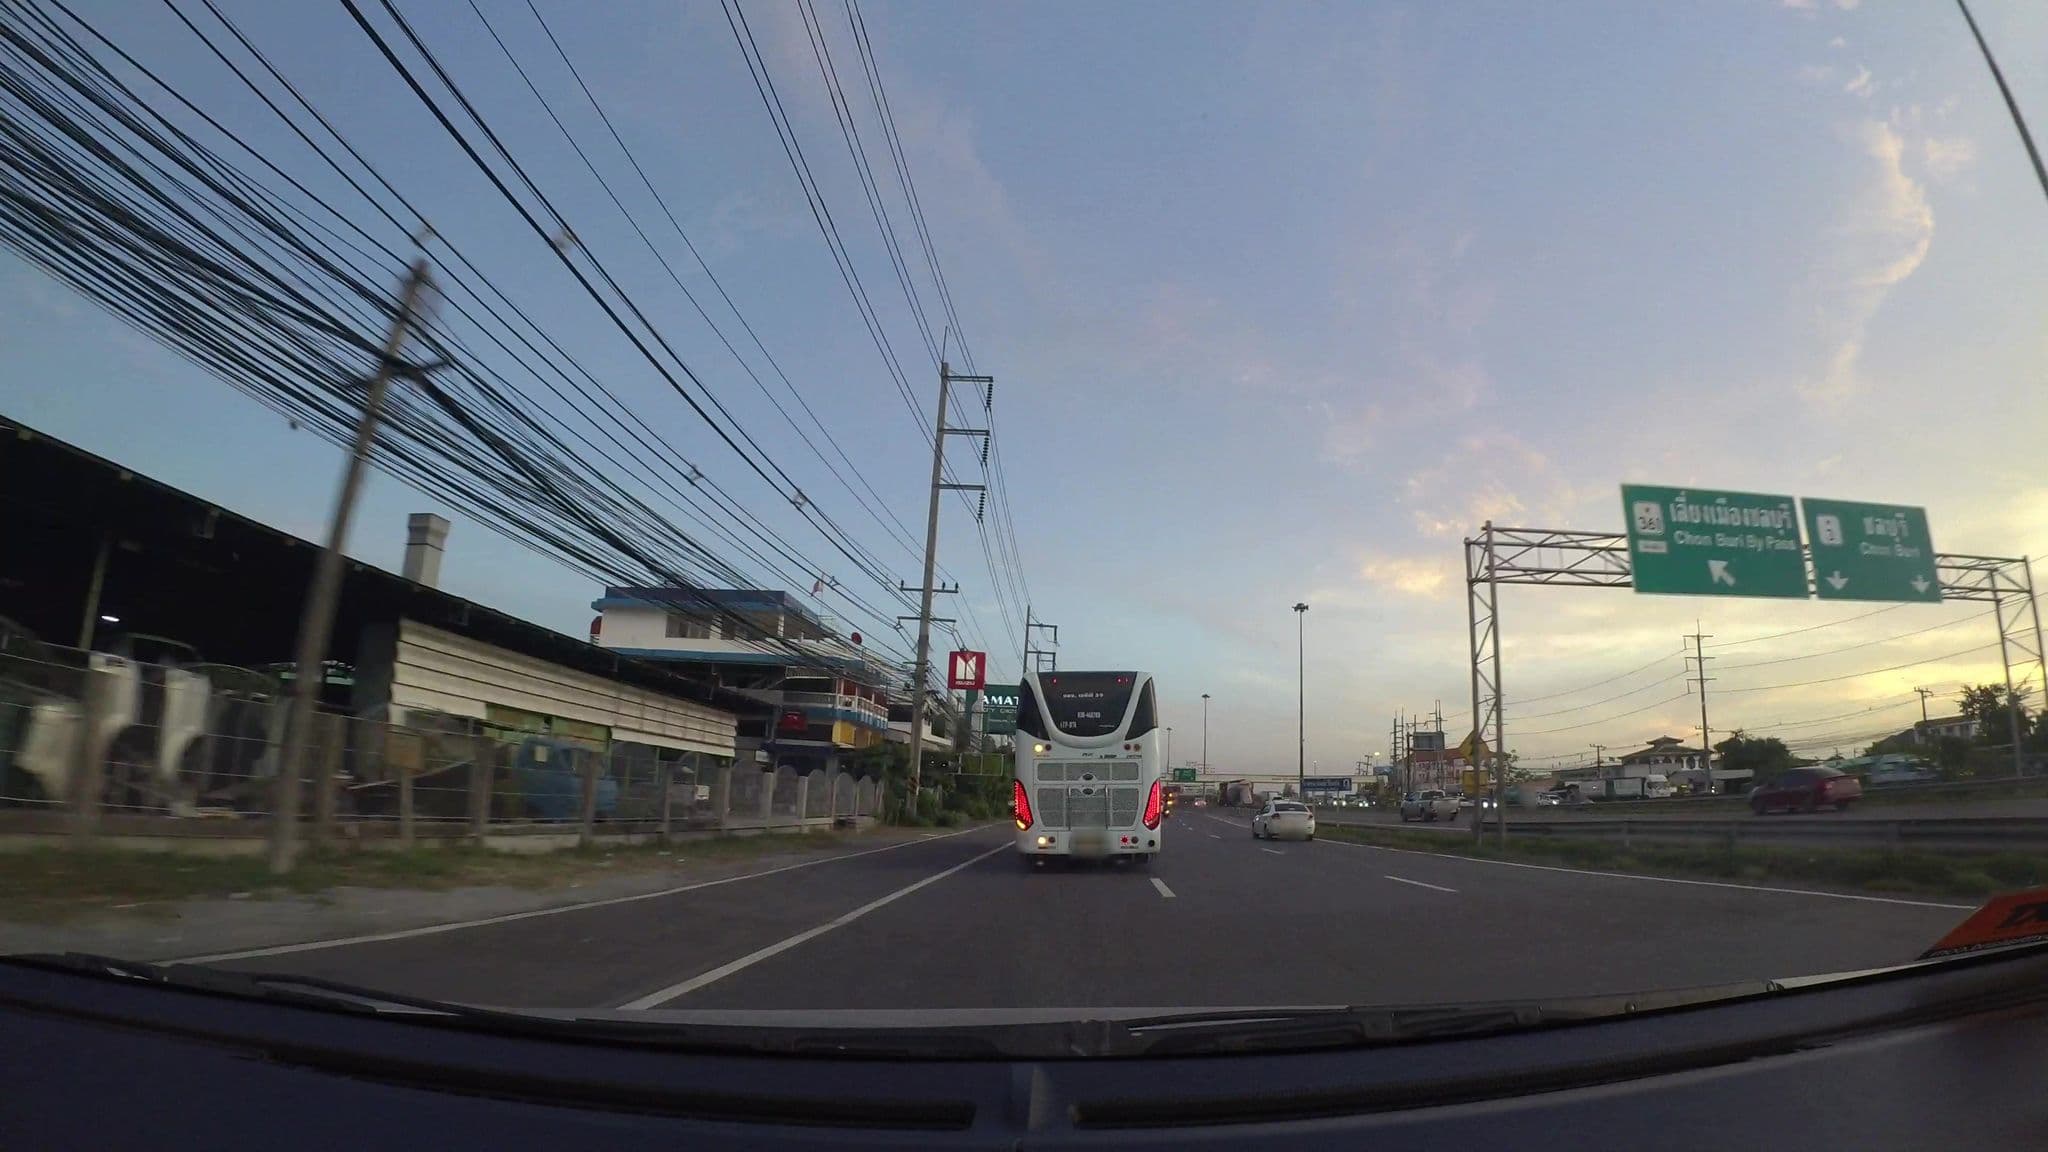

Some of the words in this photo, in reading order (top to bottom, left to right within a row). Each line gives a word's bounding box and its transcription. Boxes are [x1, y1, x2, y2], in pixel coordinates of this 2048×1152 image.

[1673, 530, 1712, 546] Chon
[1714, 533, 1745, 548] Buri
[1747, 535, 1762, 552] By
[1765, 536, 1797, 551] Pass
